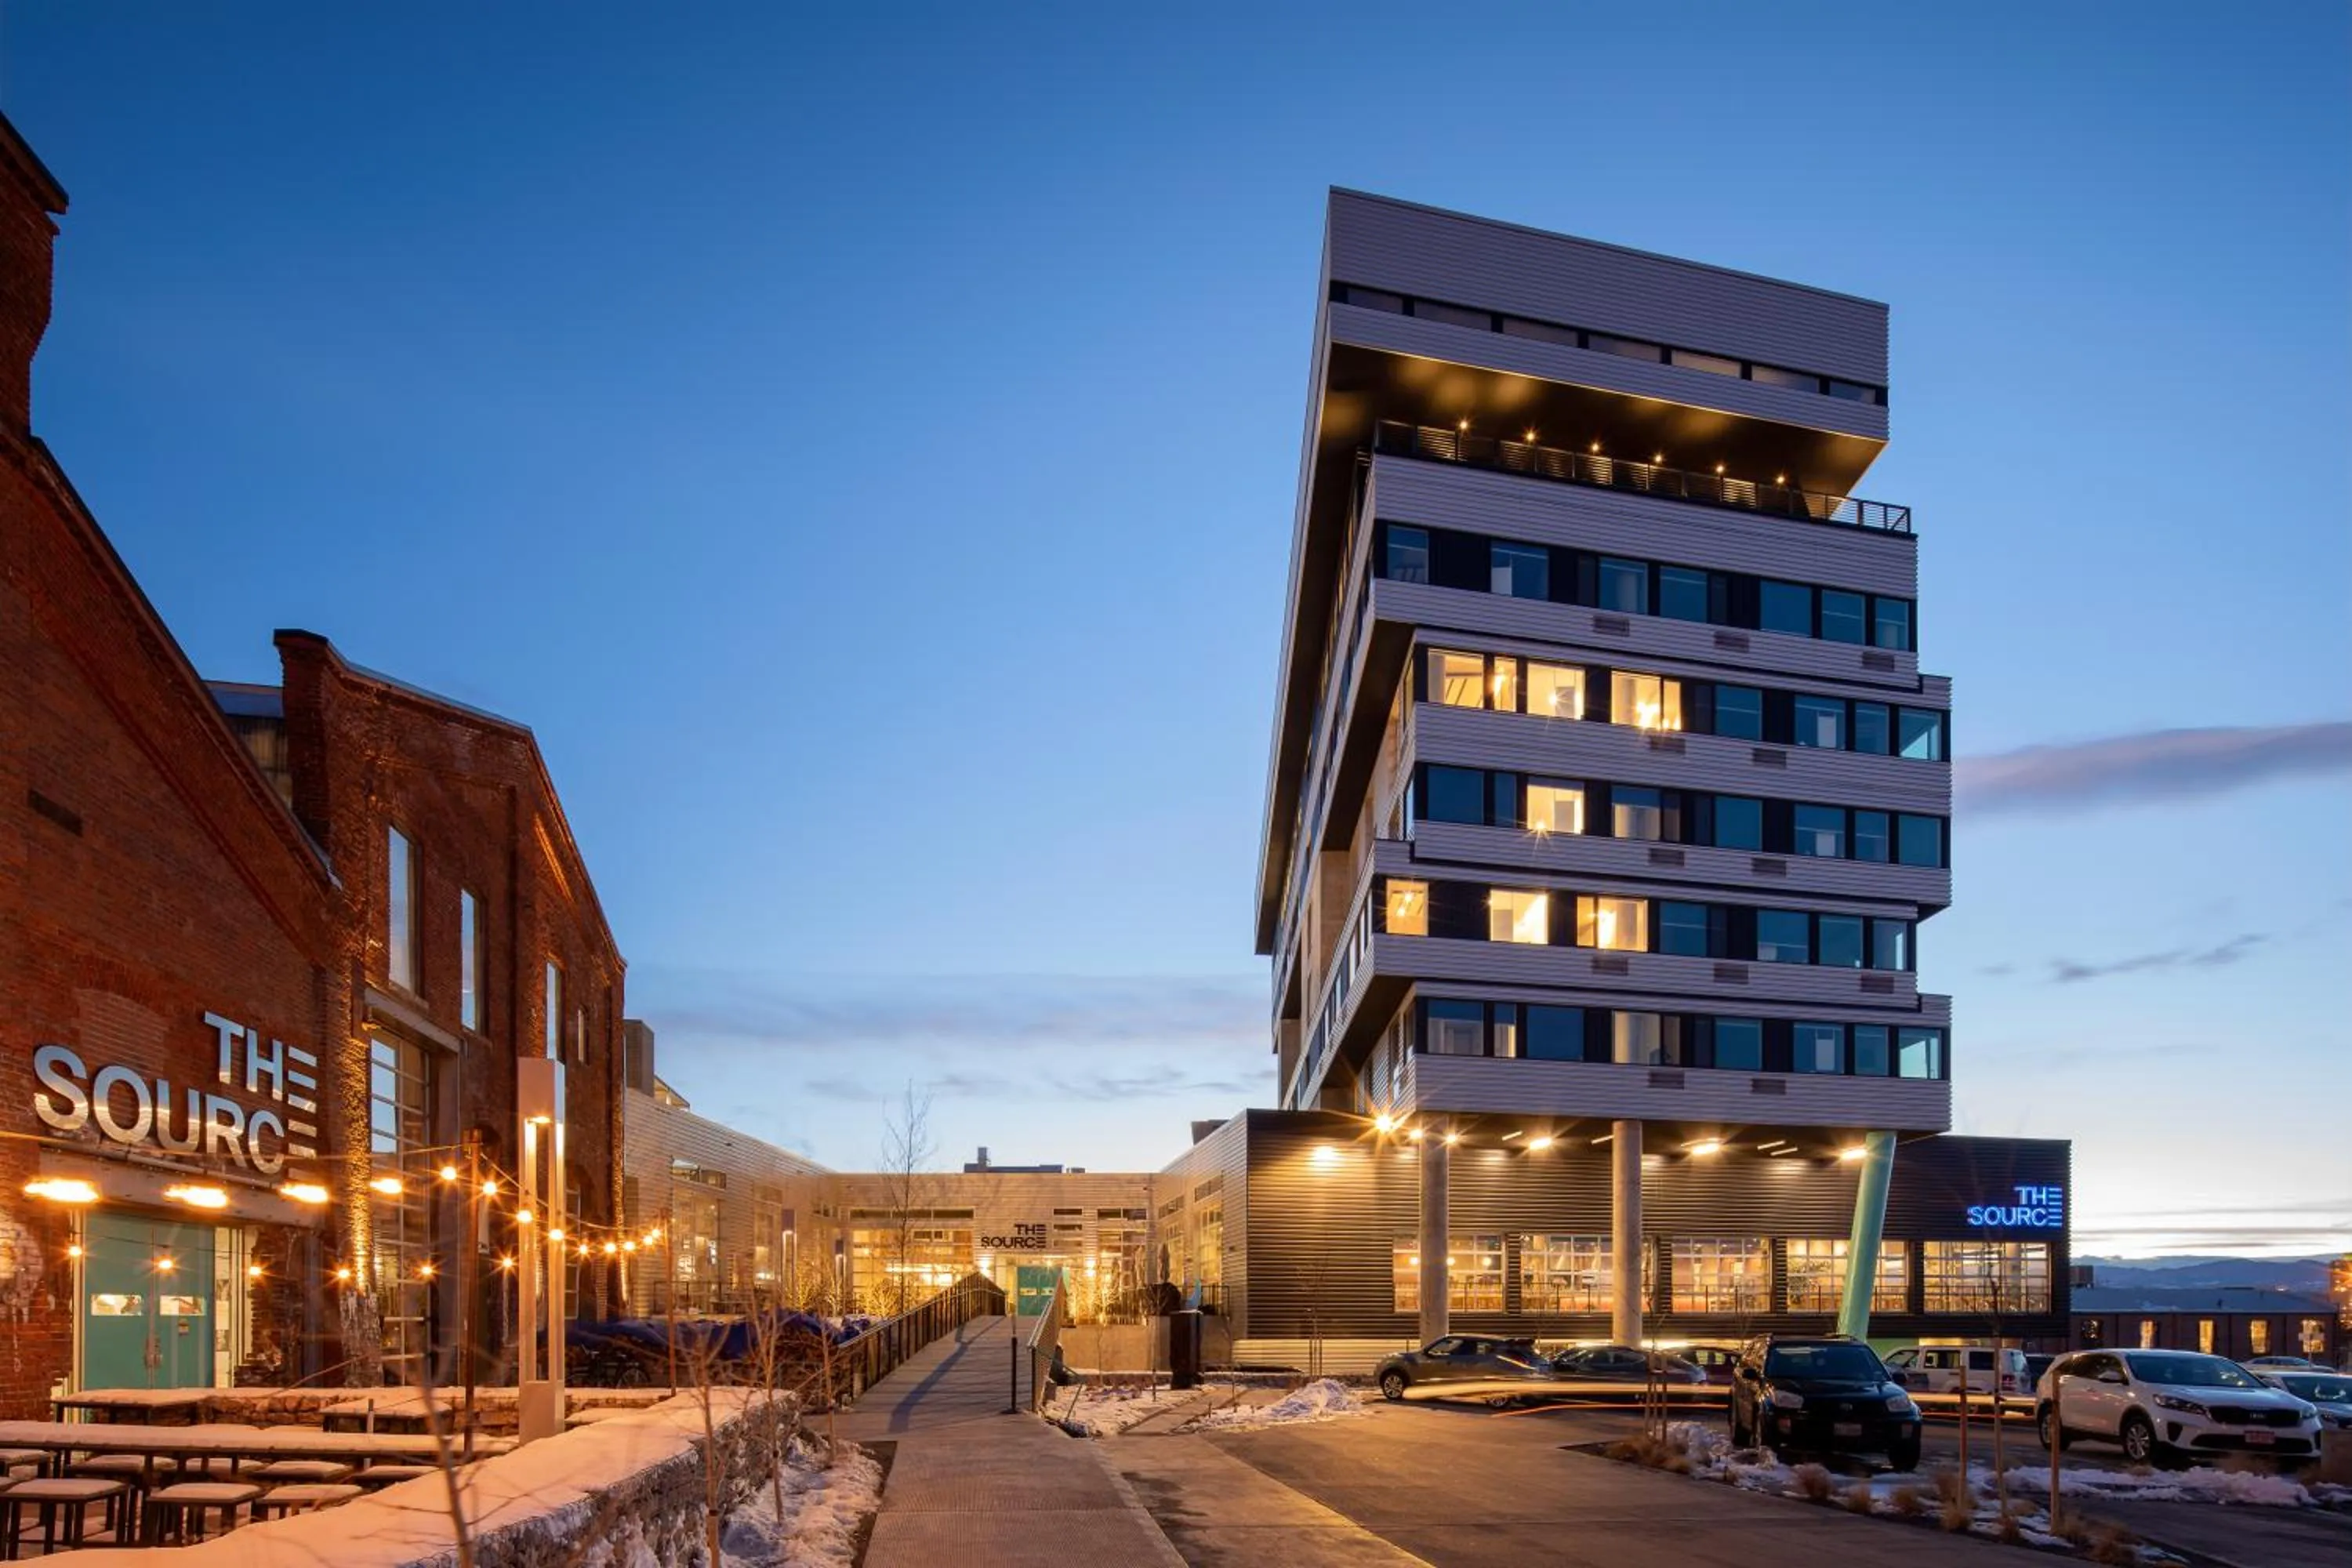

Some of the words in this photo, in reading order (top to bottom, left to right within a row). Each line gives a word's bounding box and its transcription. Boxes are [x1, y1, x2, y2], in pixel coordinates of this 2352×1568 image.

[205, 1011, 317, 1113] THE
[34, 1044, 317, 1181] SOURCE
[2014, 1186, 2063, 1205] THE
[1967, 1206, 2063, 1226] SOURCE
[1014, 1224, 1047, 1236] THE
[981, 1236, 1047, 1249] SOURCE
